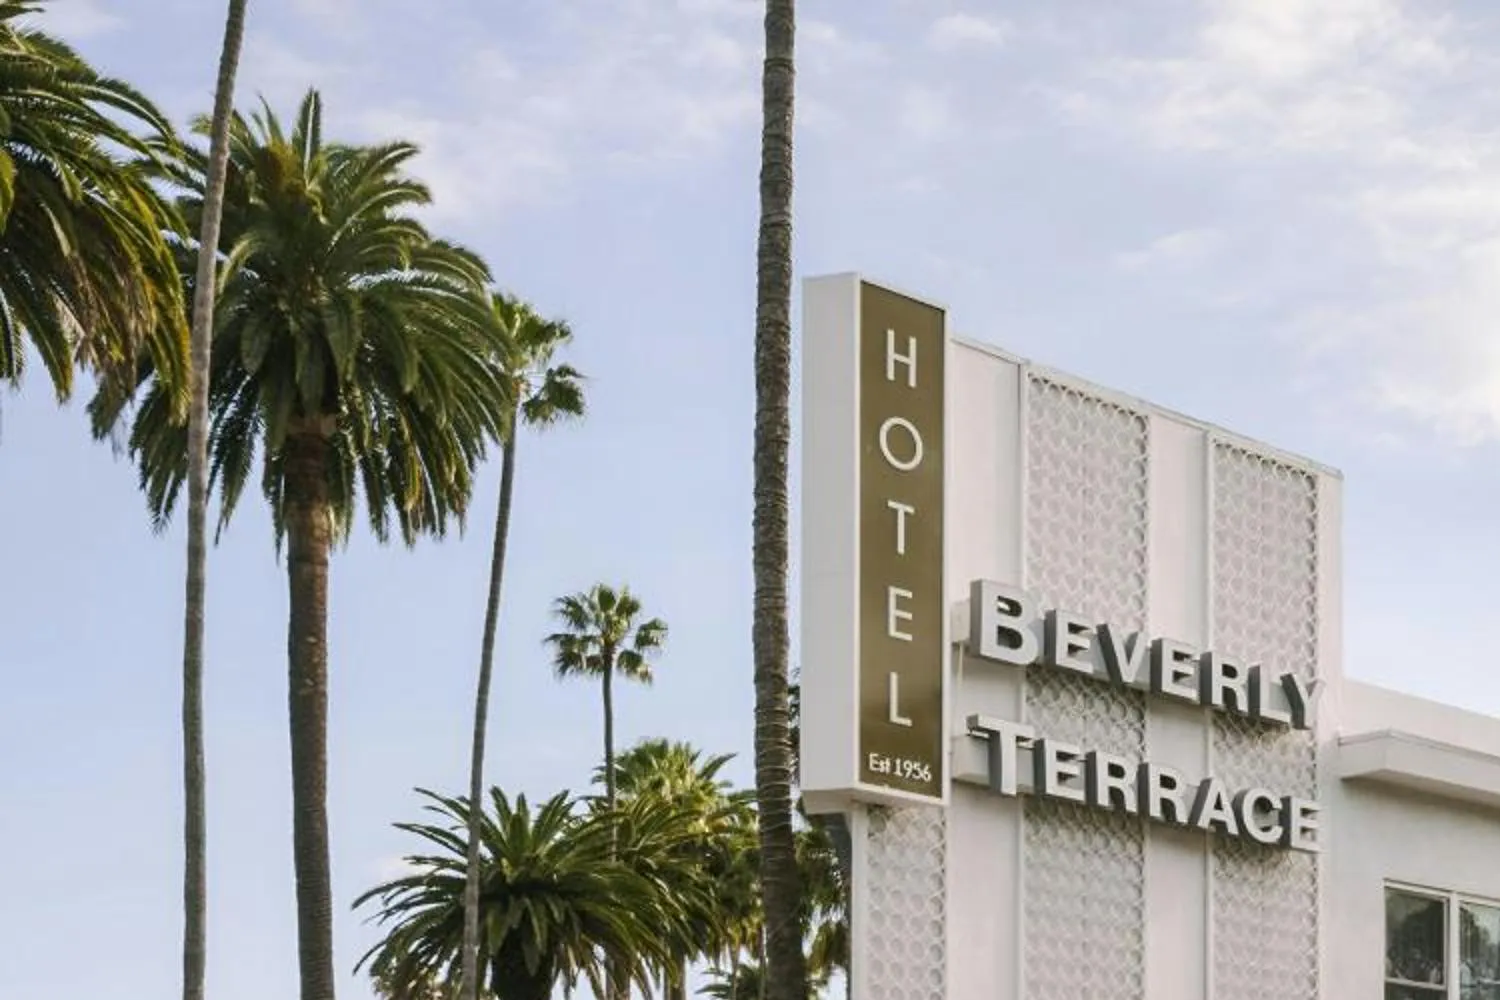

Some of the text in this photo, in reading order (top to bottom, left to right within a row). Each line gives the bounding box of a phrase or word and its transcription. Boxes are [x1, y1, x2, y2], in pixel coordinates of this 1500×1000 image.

[879, 328, 924, 728] HOTEL
[970, 578, 1325, 730] BEVERLY
[869, 752, 932, 783] Est 1956
[966, 713, 1324, 853] TERRACE
